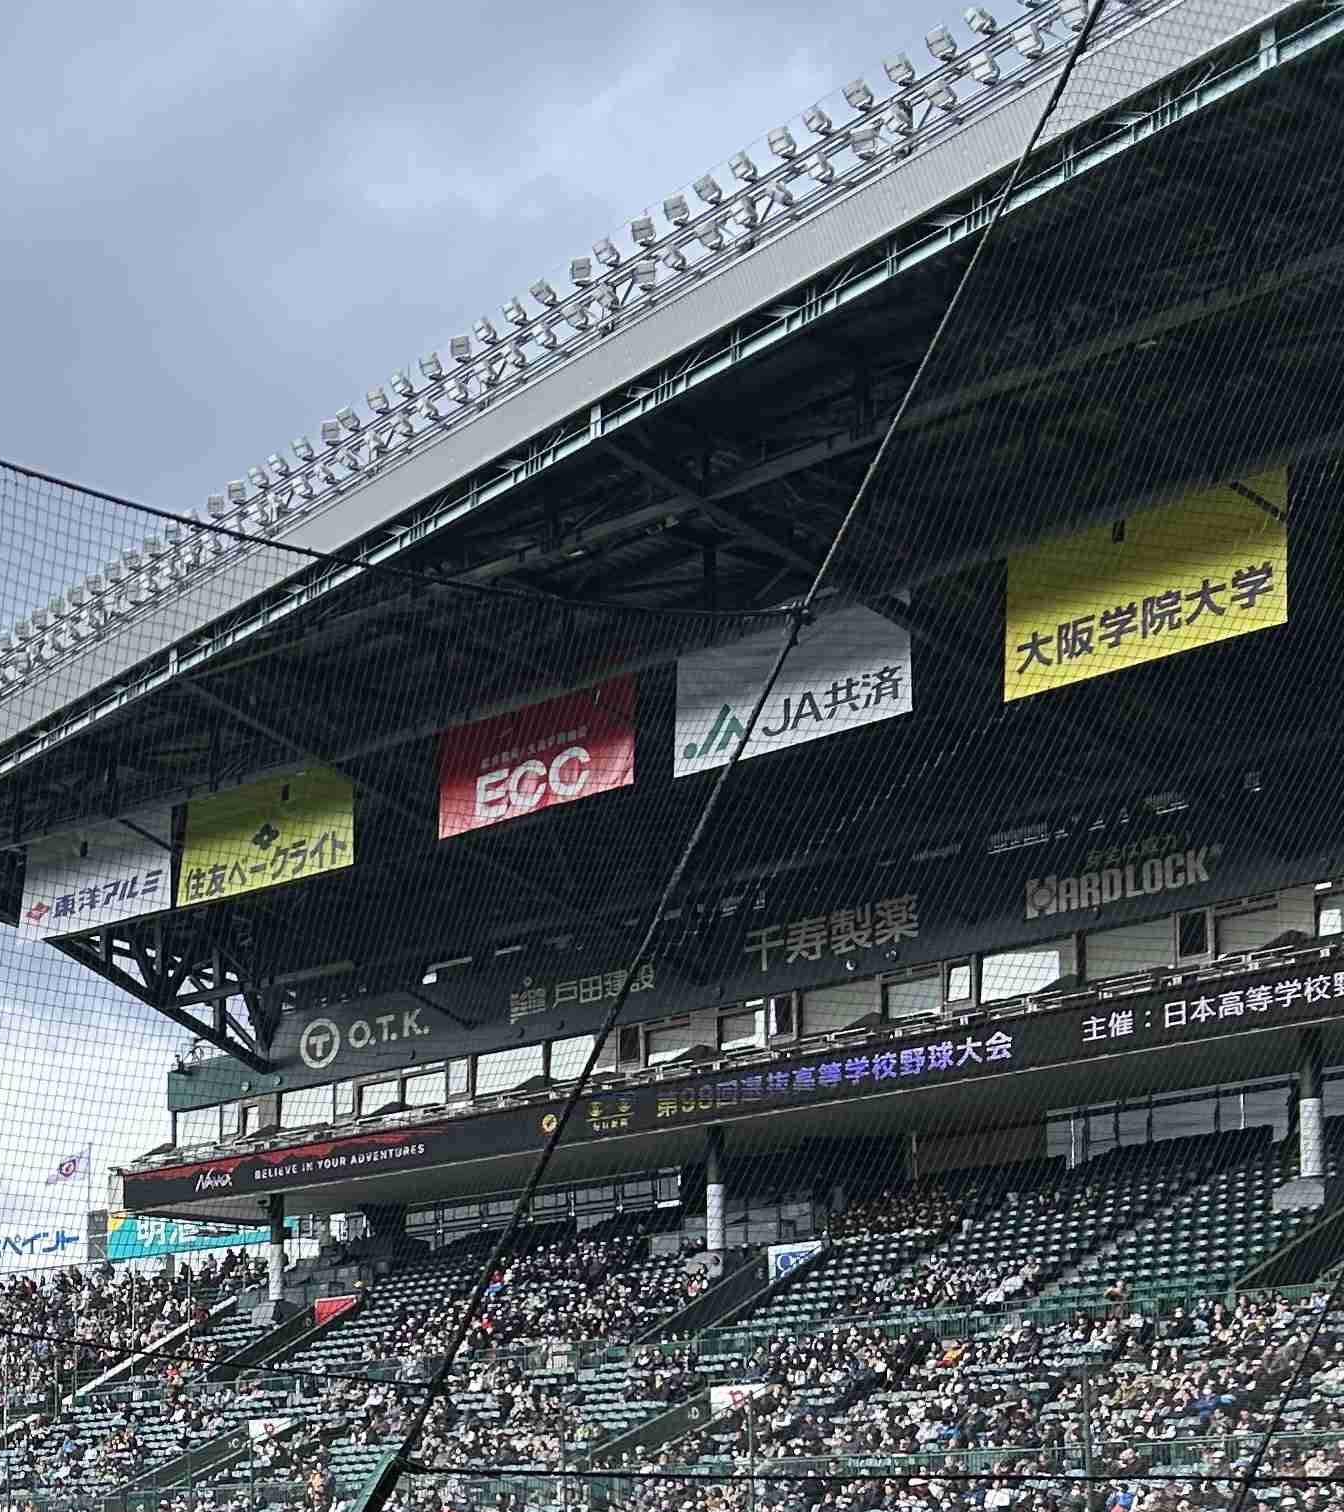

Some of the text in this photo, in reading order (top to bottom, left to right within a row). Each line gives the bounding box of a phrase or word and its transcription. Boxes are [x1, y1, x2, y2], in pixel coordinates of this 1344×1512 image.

[1017, 561, 1274, 674] 大阪学院大学
[763, 665, 903, 738] JA共済
[475, 746, 591, 818] ECC
[53, 868, 164, 918] 東洋アルミ
[185, 830, 347, 900] 住友ベークライト
[1025, 848, 1210, 919] HARDLOCK
[746, 893, 919, 971] 千寿製薬
[553, 964, 656, 1008] 戸田建設
[348, 1007, 430, 1049] O.T.K.
[254, 1165, 298, 1180] BELIEVE
[317, 1157, 346, 1170] YOUR
[350, 1144, 425, 1165] ADVENTURES
